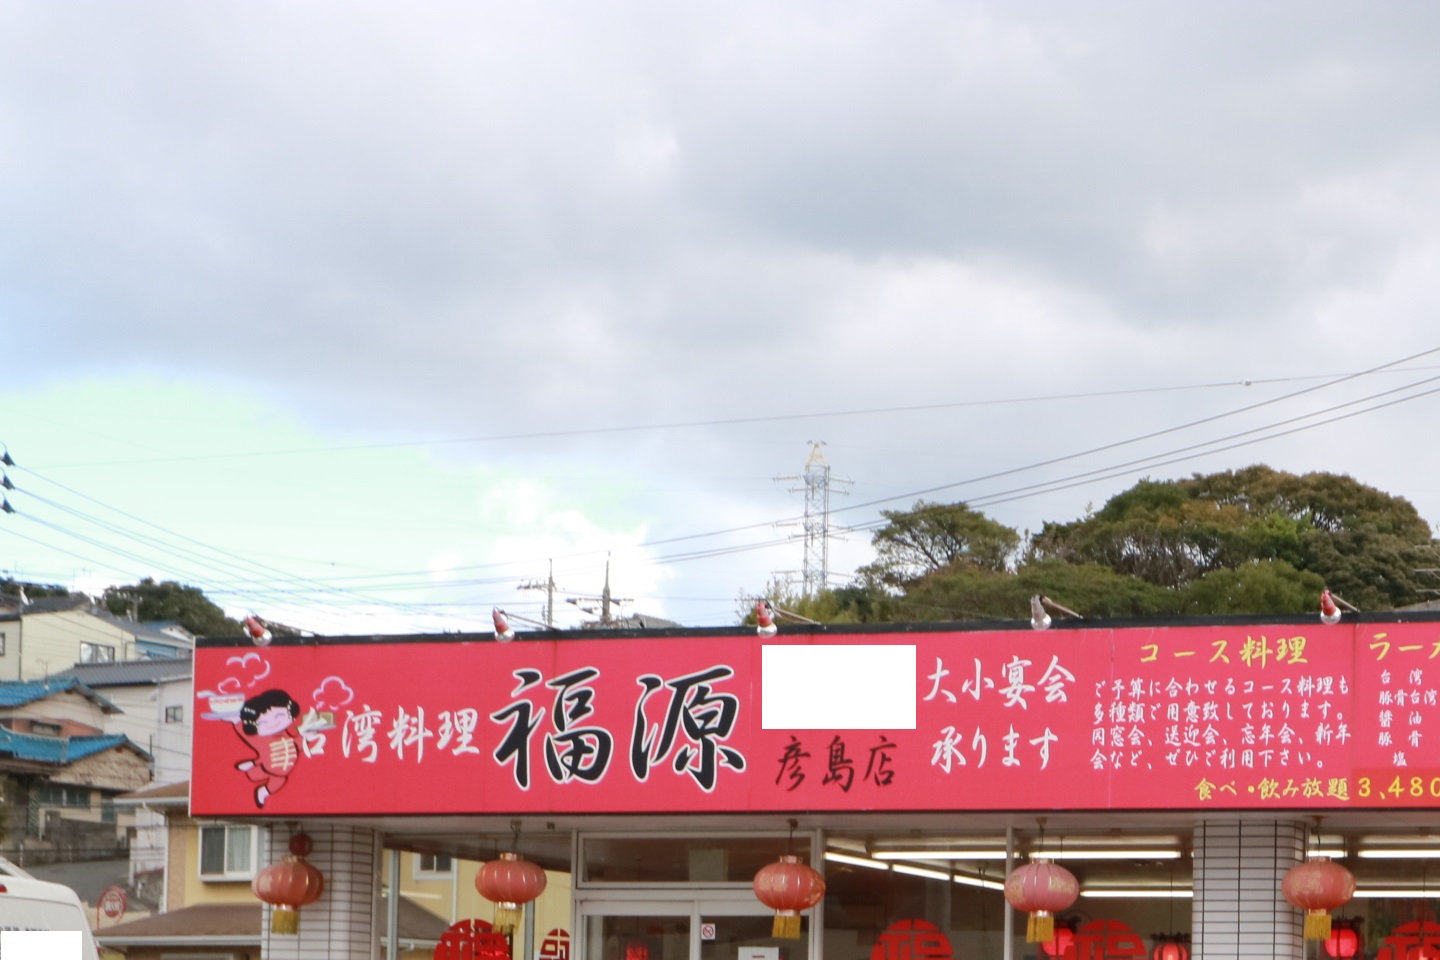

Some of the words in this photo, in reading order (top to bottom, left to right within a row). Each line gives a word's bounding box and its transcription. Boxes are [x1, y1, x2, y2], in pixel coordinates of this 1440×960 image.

[1140, 635, 1308, 669] コース料理
[922, 655, 1076, 710] 大小宴会
[1095, 675, 1349, 698] ご予算に合わせるコース料理も
[488, 663, 748, 794] 福源
[1093, 700, 1344, 724] 多種類ご用意致しております。
[297, 704, 480, 764] 台湾料理
[930, 723, 1059, 774] 承ります
[1090, 748, 1323, 770] 会など、ぜひご利用下さい。
